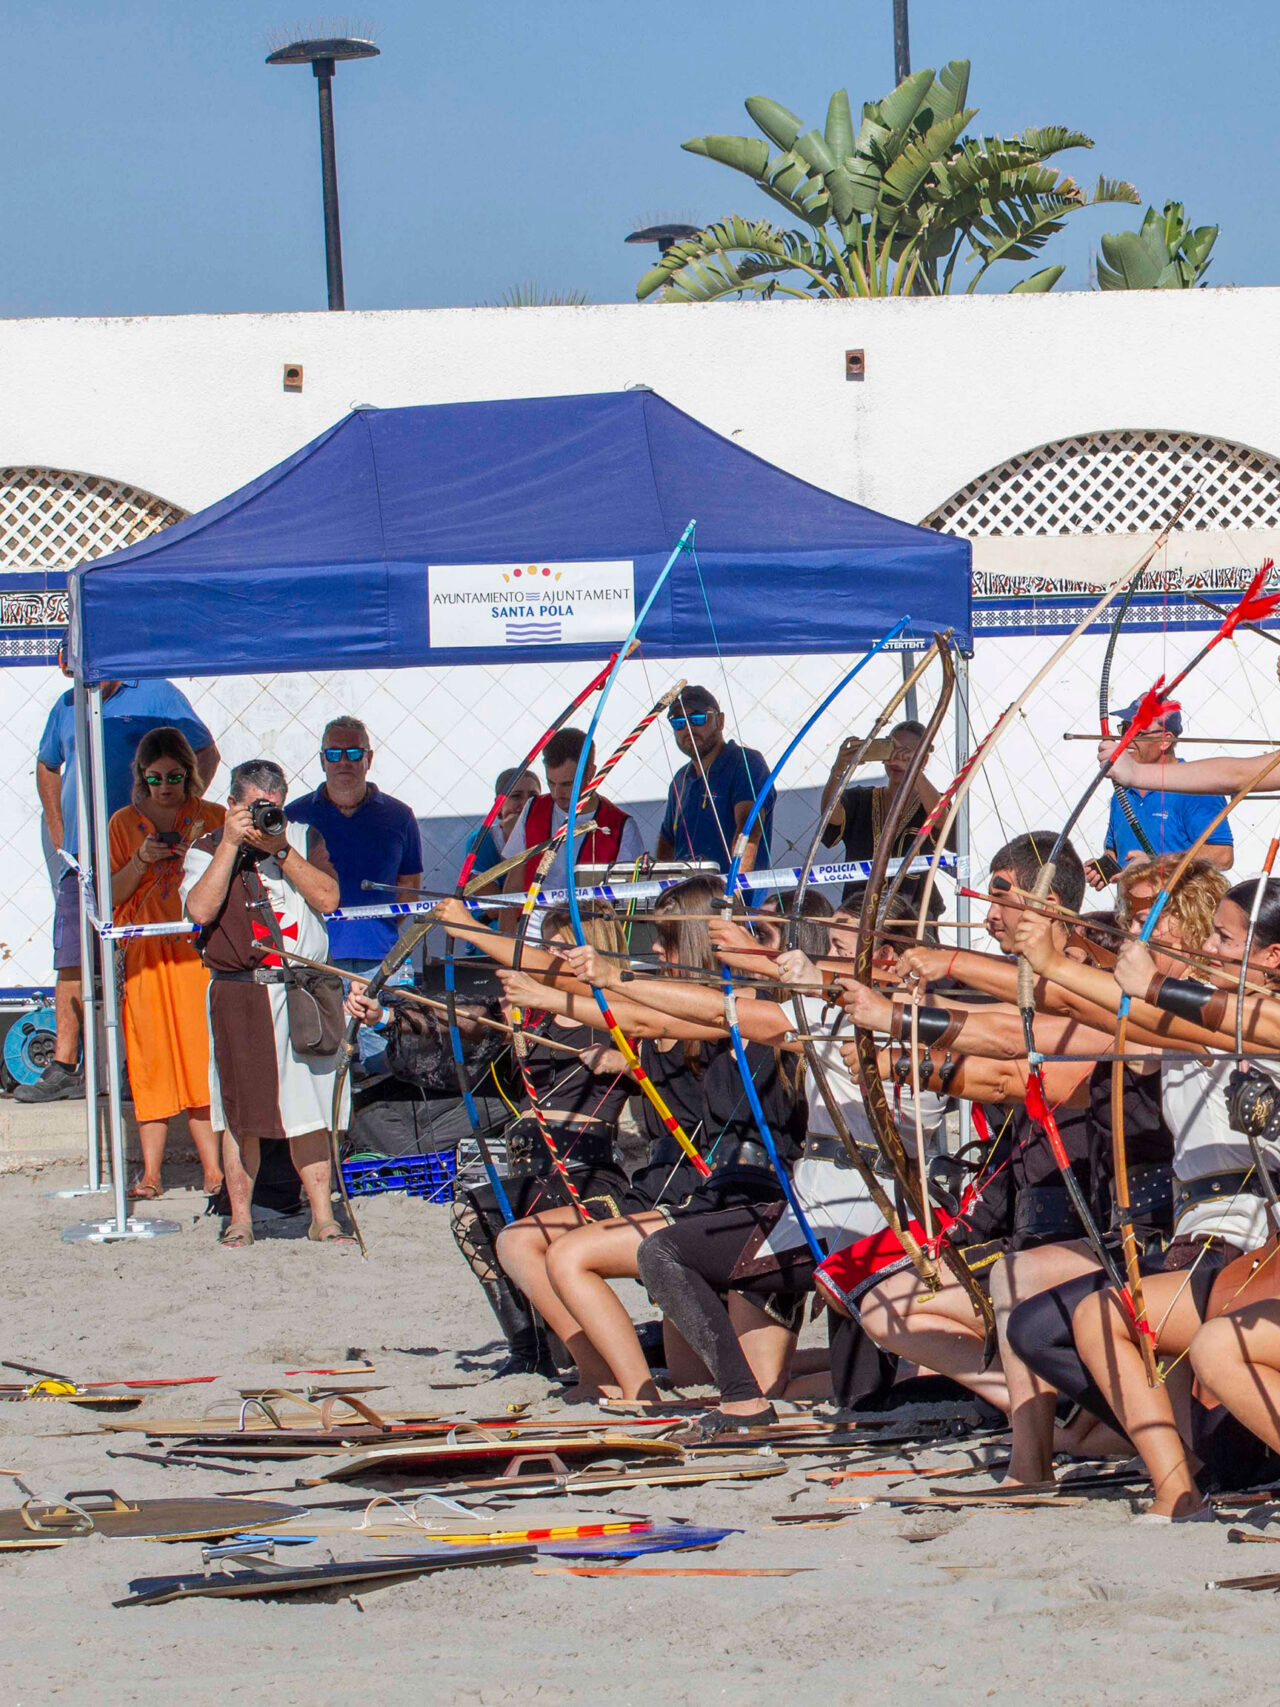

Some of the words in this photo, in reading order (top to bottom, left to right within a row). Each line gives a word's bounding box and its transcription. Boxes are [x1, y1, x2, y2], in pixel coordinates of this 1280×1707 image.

[433, 591, 525, 604] AYUNTAMIENTO
[542, 588, 631, 604] AJUNTAMENT
[491, 606, 535, 618] SANTA
[540, 605, 574, 616] POLA
[873, 641, 926, 650] STERTENT
[819, 863, 857, 874] POLICIA
[824, 873, 855, 882] LOCAL
